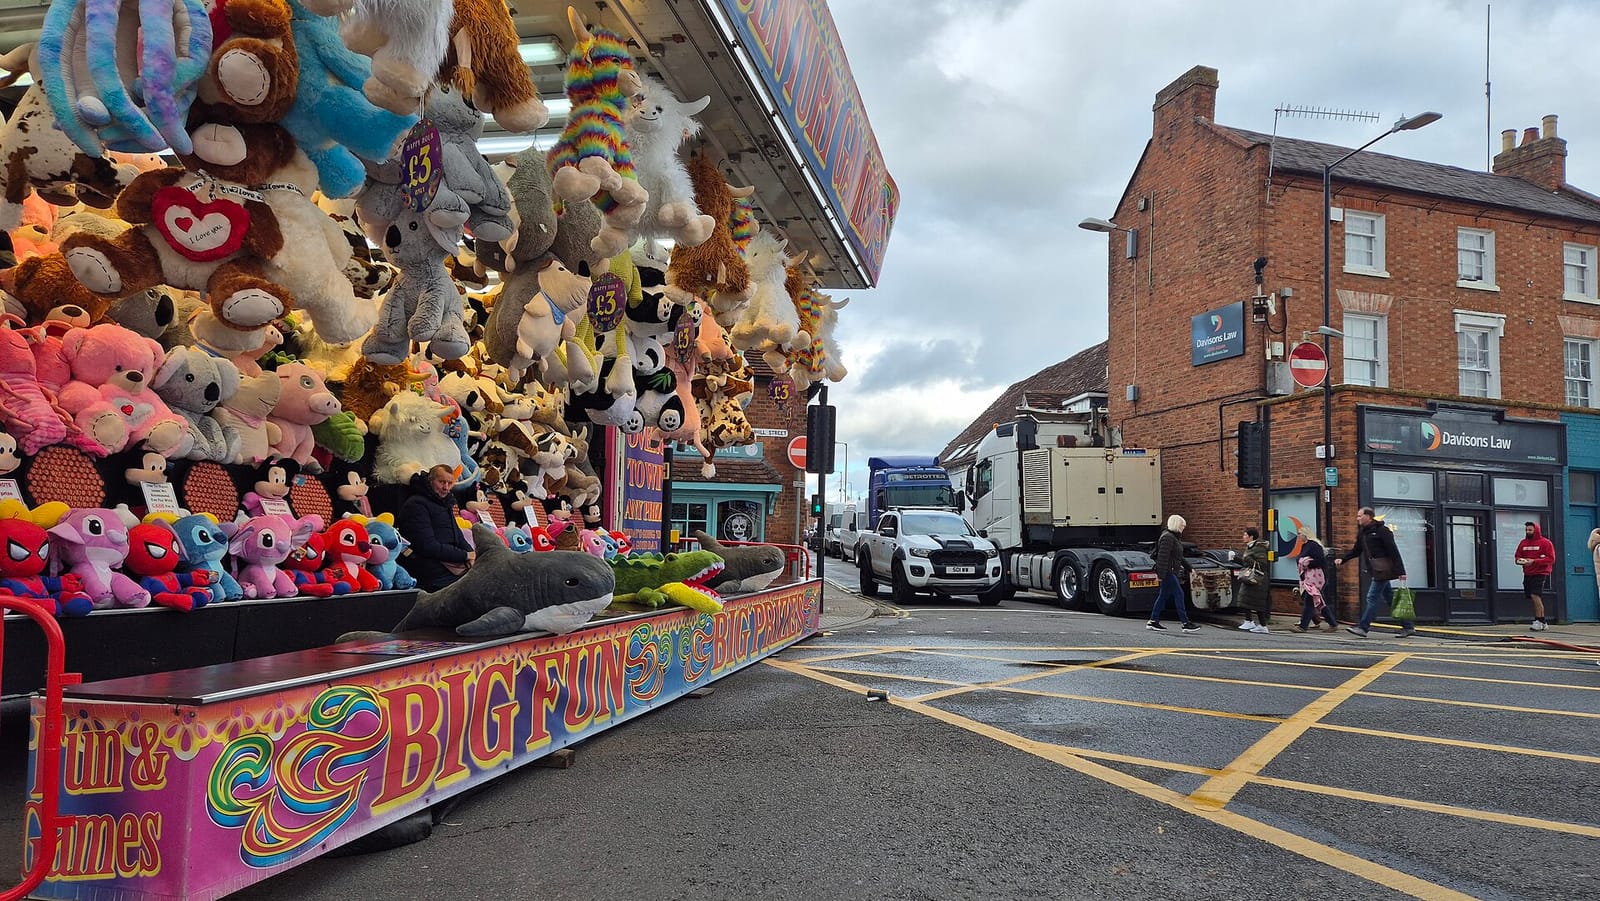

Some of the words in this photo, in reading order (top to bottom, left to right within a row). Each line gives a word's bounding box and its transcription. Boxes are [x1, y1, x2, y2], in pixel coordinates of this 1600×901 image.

[409, 144, 431, 187] £3
[196, 230, 211, 242] Love
[210, 224, 223, 235] you
[596, 290, 616, 315] £3
[678, 328, 689, 349] £3
[1196, 335, 1223, 348] Davisons
[1223, 331, 1237, 341] Law
[774, 384, 789, 400] £3
[1442, 432, 1489, 448] Davisons
[1490, 435, 1512, 450] Law
[710, 607, 750, 676] BIG
[750, 593, 805, 659] PRIZES
[370, 659, 520, 817] BIG
[525, 634, 630, 753] FUN
[130, 722, 170, 790] &
